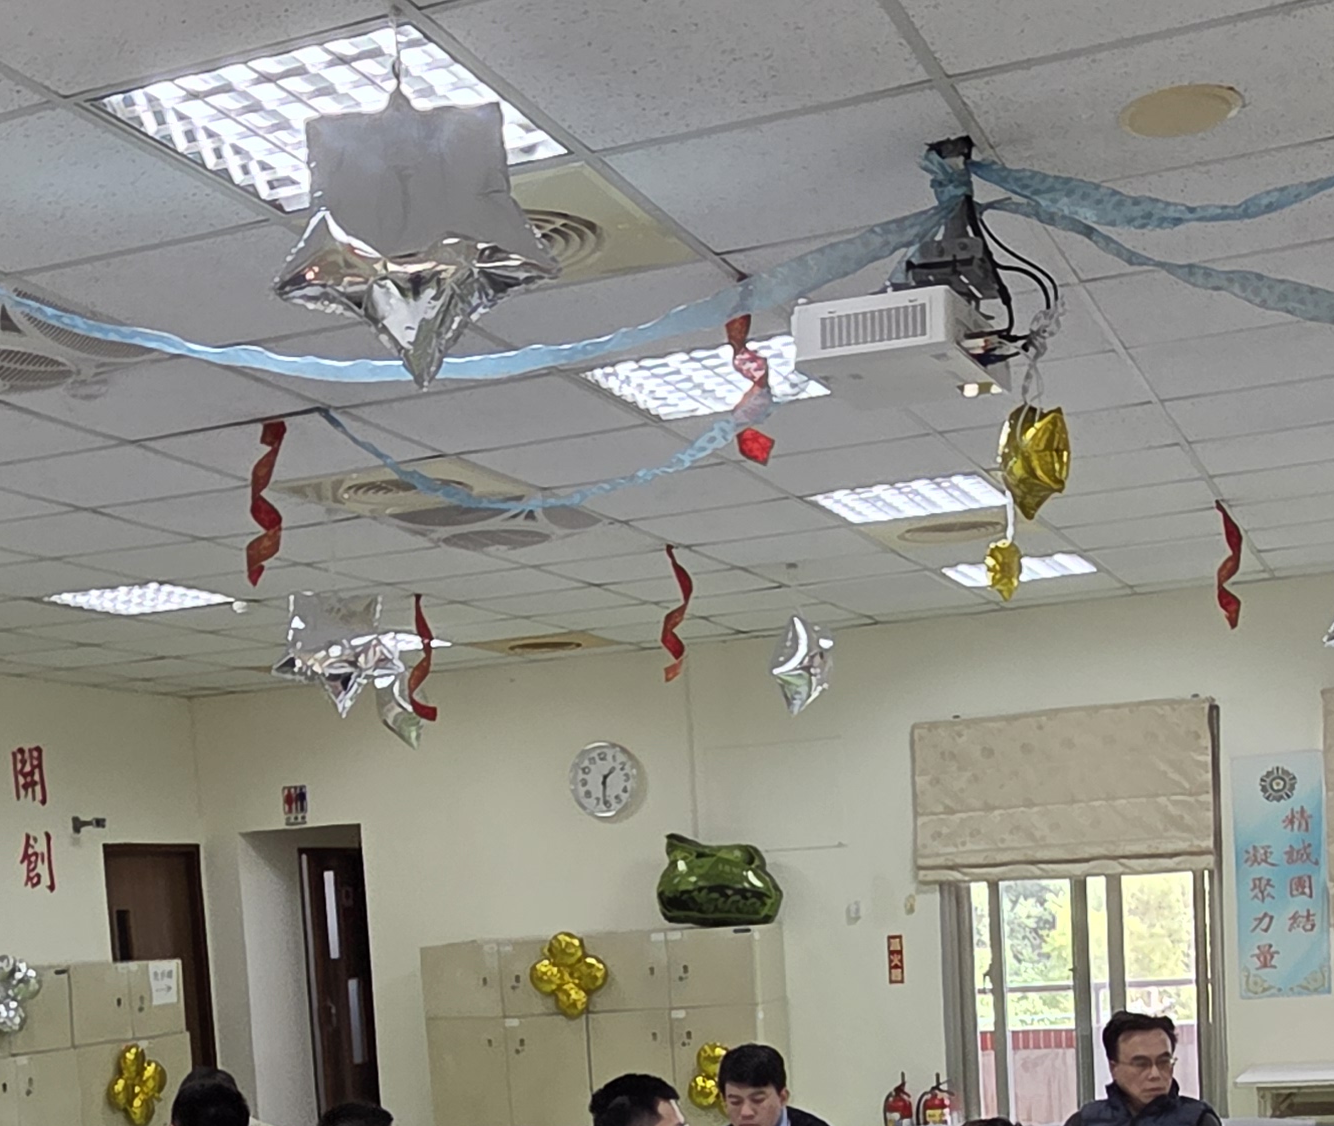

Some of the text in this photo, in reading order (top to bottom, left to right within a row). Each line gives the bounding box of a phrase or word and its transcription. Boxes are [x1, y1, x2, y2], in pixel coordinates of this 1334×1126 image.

[11, 746, 56, 893] 開創
[1282, 805, 1320, 933] 精誠團結
[1244, 844, 1281, 971] 凝聚力量
